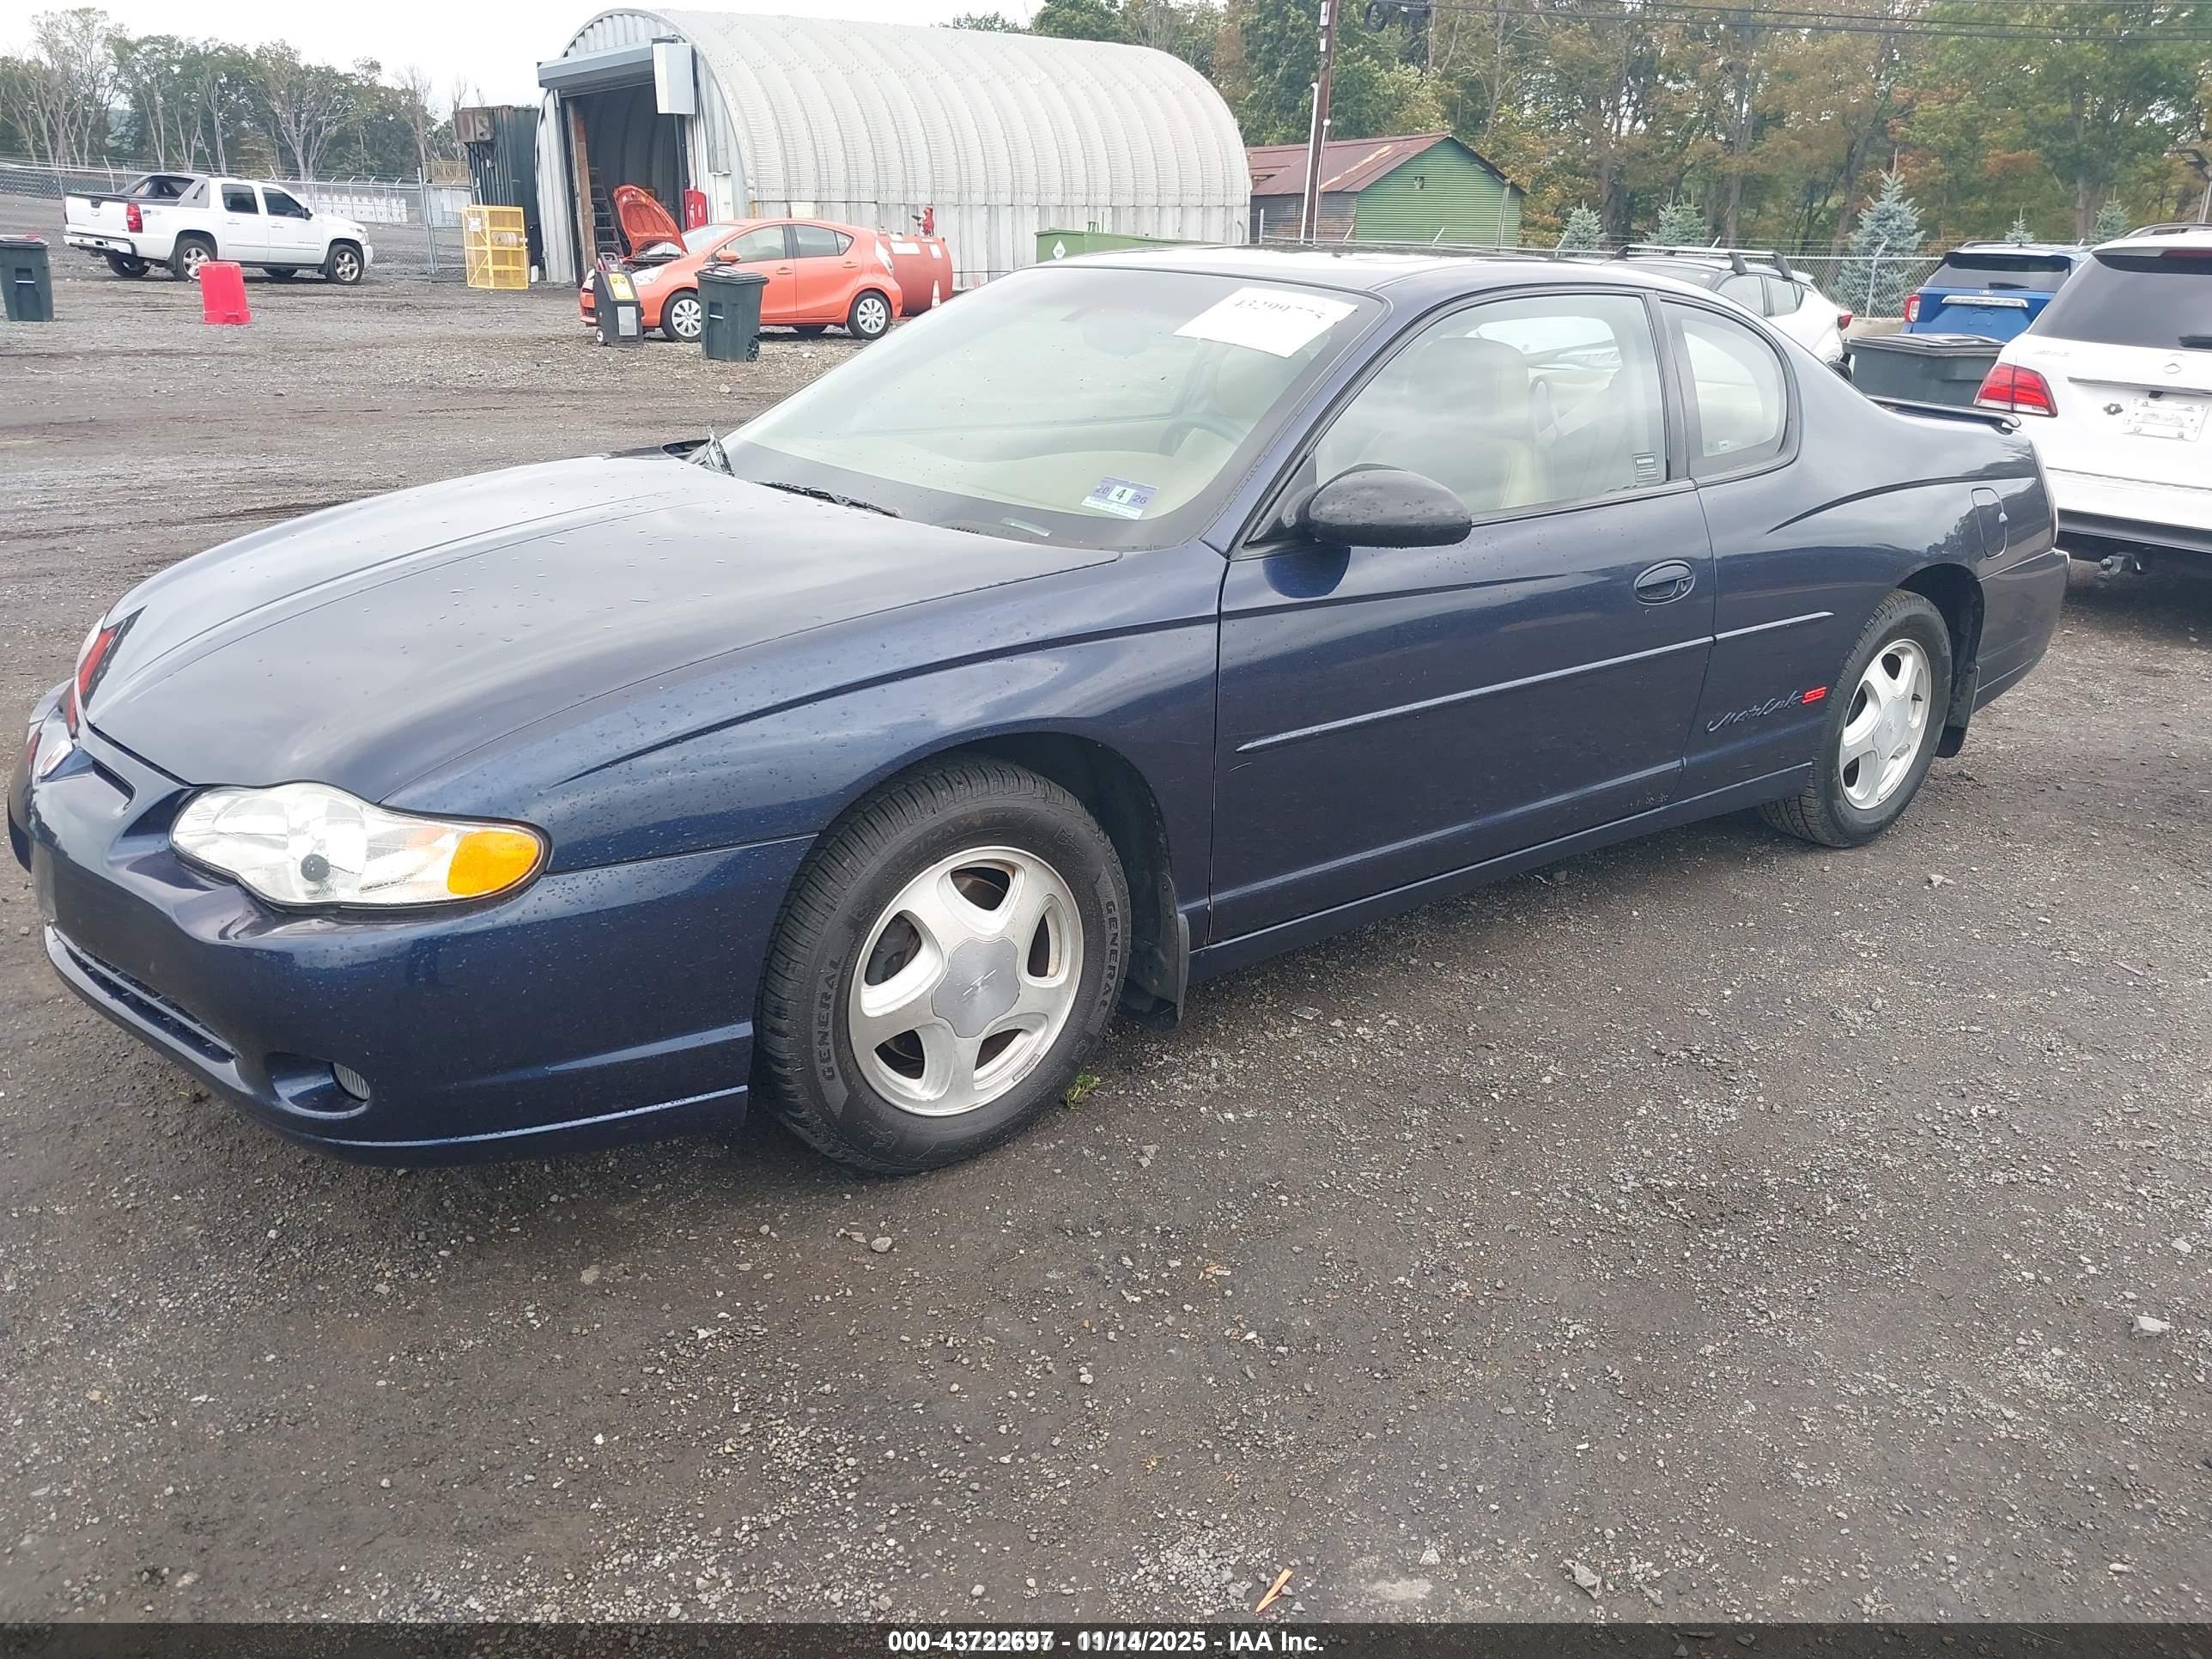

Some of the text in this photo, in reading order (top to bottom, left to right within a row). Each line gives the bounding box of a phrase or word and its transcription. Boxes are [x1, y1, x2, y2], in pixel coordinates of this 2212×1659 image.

[1116, 489, 1127, 500] 4
[1133, 494, 1148, 505] 26
[818, 956, 843, 1081] GENERAL
